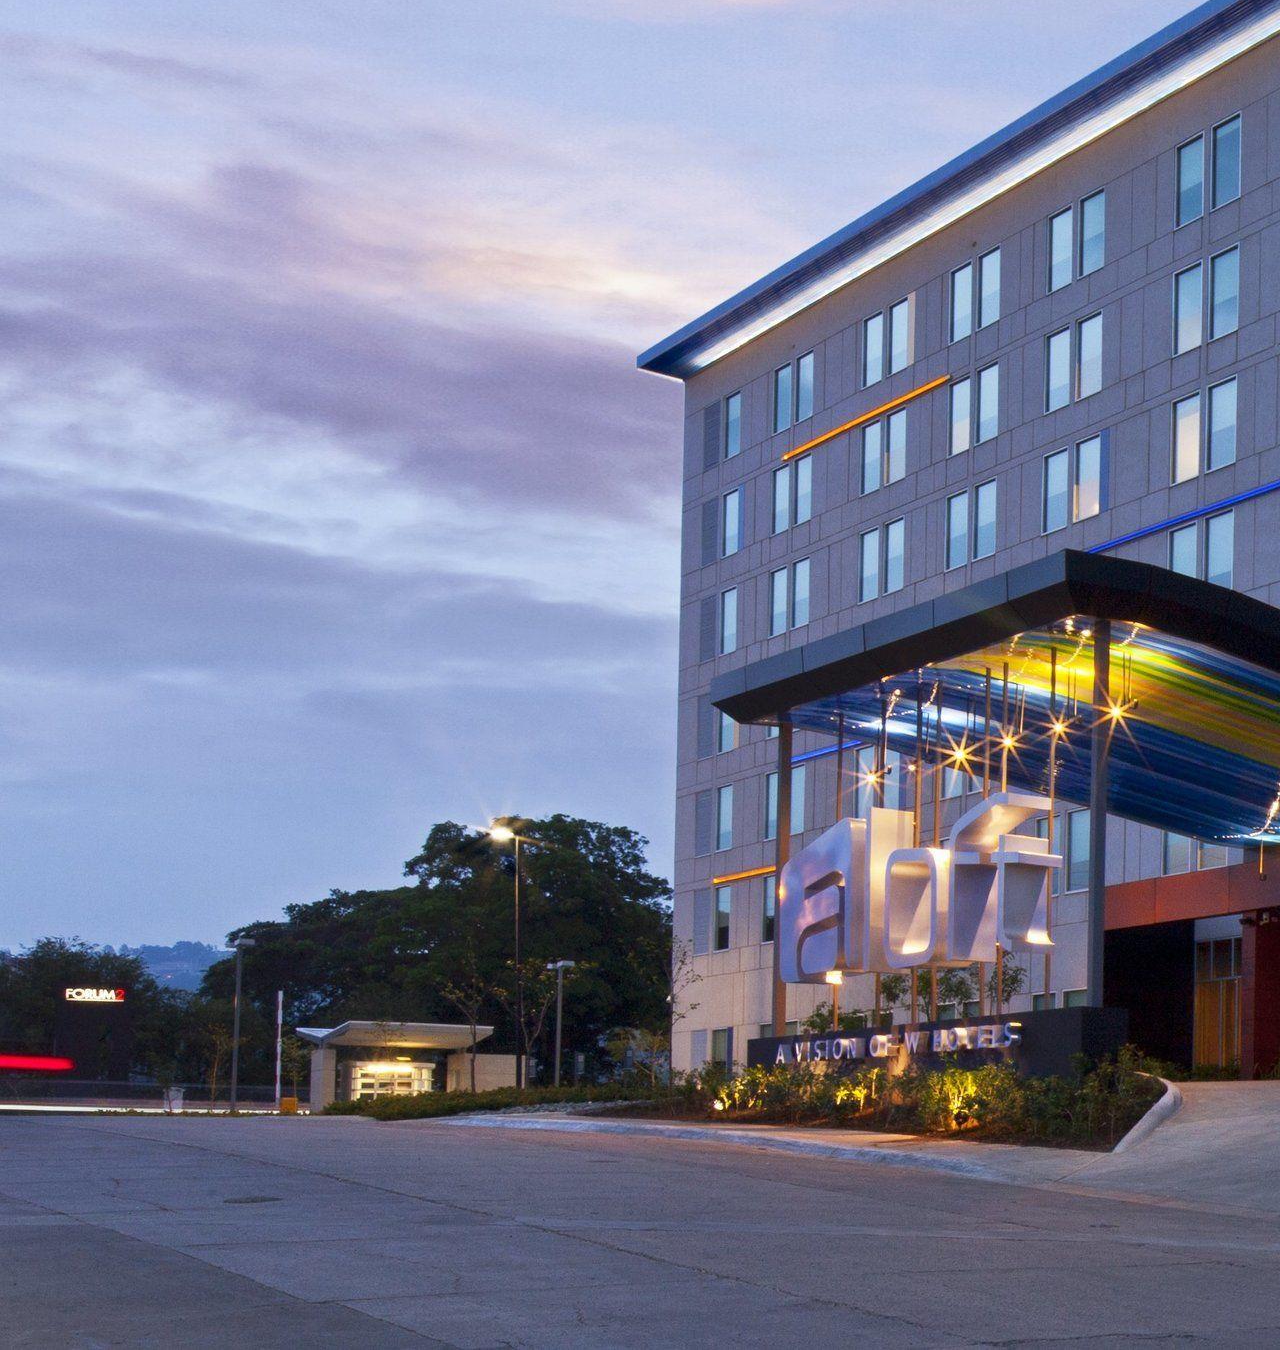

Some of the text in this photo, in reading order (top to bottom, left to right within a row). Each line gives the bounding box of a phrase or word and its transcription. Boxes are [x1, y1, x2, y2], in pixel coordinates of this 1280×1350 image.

[778, 791, 1064, 985] aloft
[775, 1021, 1022, 1065] A VISION OF W HOTELS
